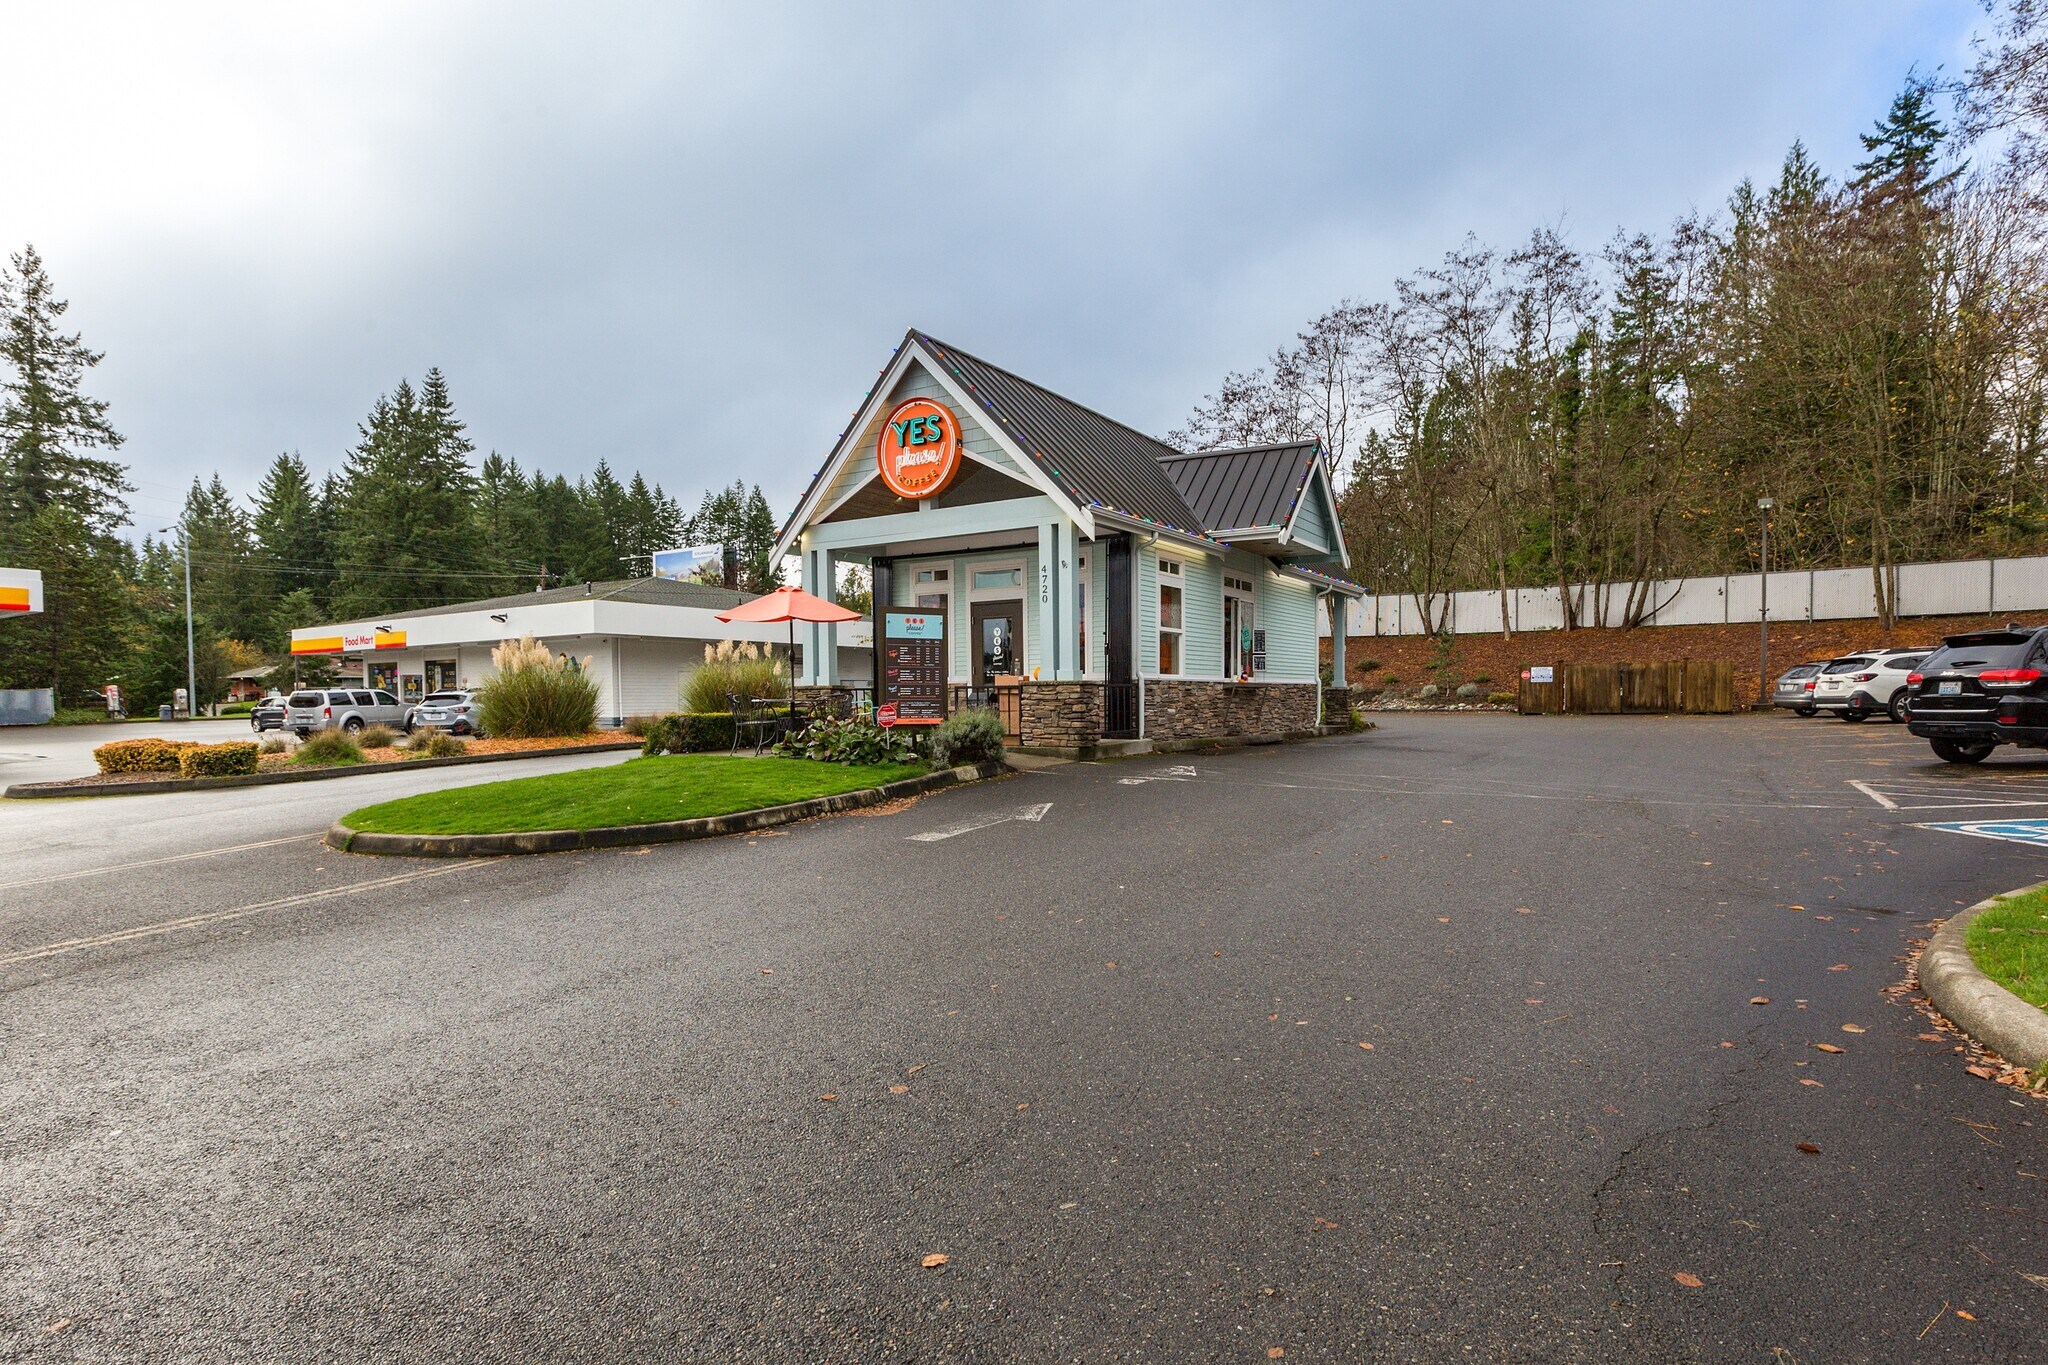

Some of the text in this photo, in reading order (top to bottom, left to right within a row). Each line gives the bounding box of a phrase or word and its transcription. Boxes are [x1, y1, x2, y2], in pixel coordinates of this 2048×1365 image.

[892, 415, 942, 447] YES
[895, 442, 946, 476] please!
[898, 469, 938, 486] COFFEE
[345, 635, 373, 646] Food Mart
